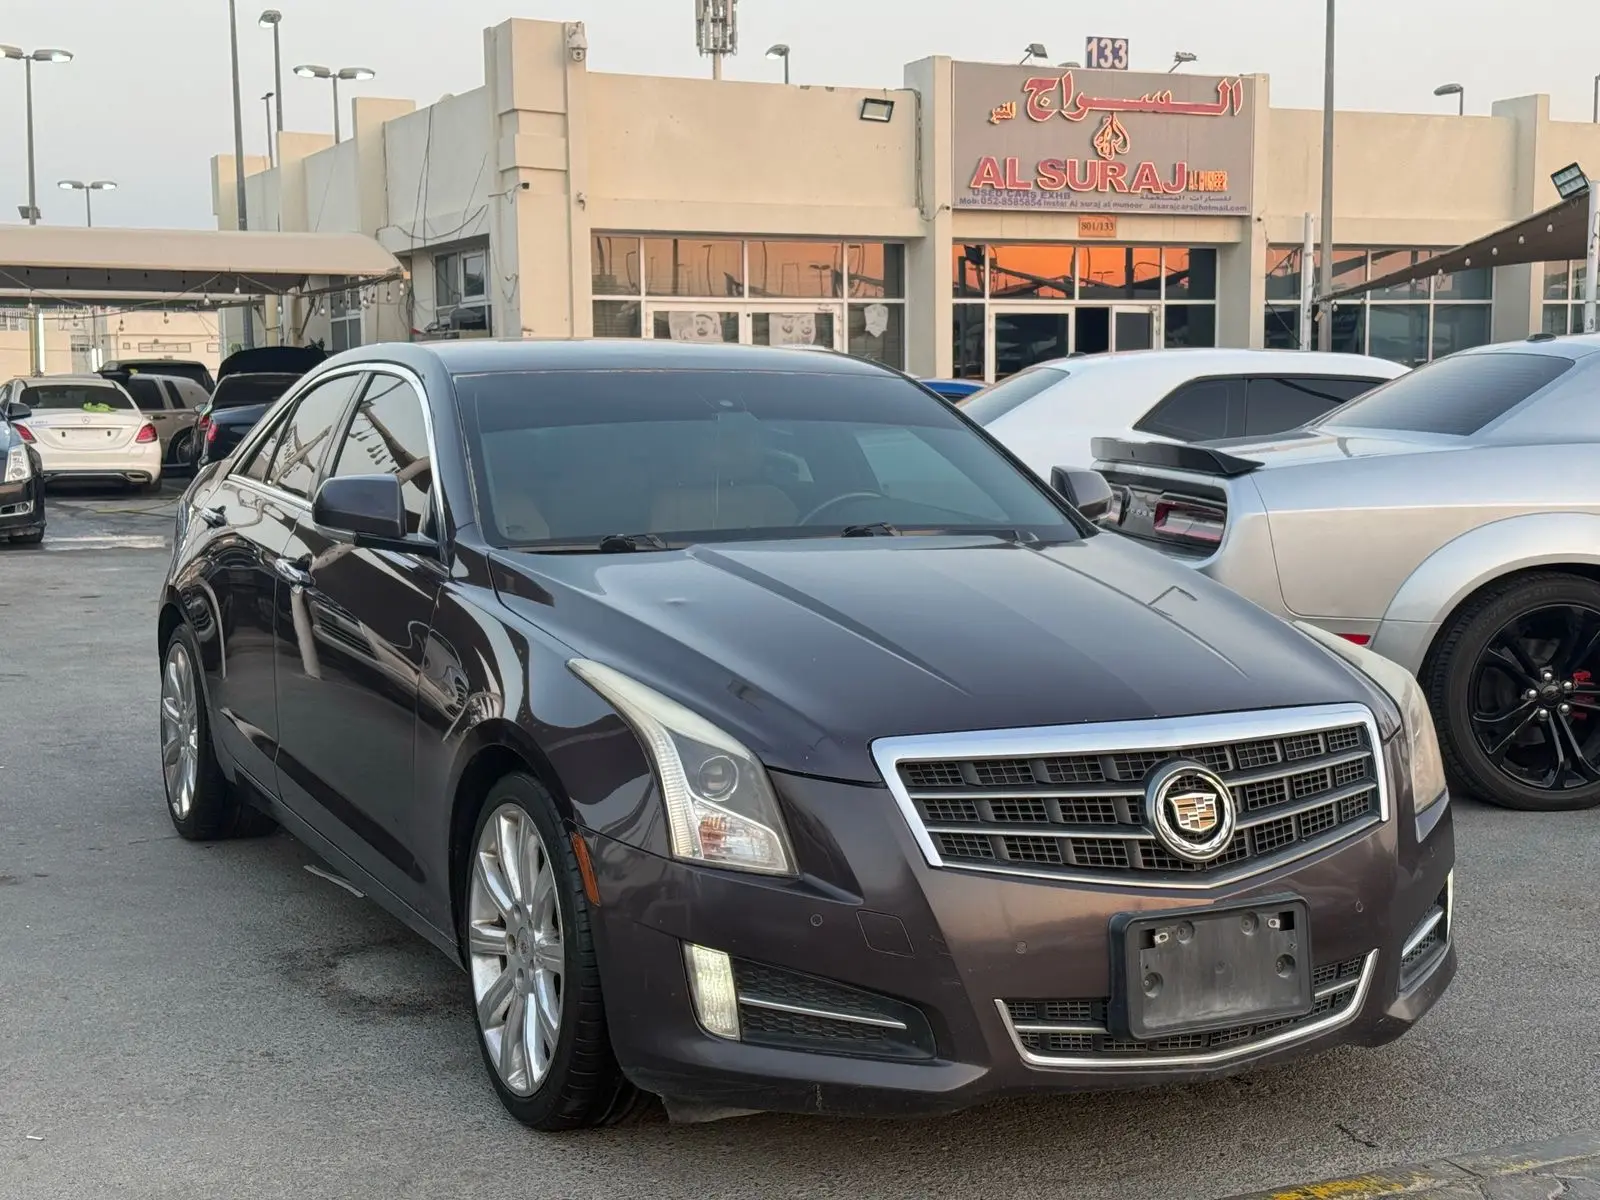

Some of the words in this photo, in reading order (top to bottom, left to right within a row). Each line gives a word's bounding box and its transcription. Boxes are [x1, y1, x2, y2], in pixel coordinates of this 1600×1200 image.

[1086, 38, 1128, 68] 133
[1023, 70, 1243, 122] السراج
[970, 156, 1033, 190] AL
[1037, 160, 1188, 193] SURAJ
